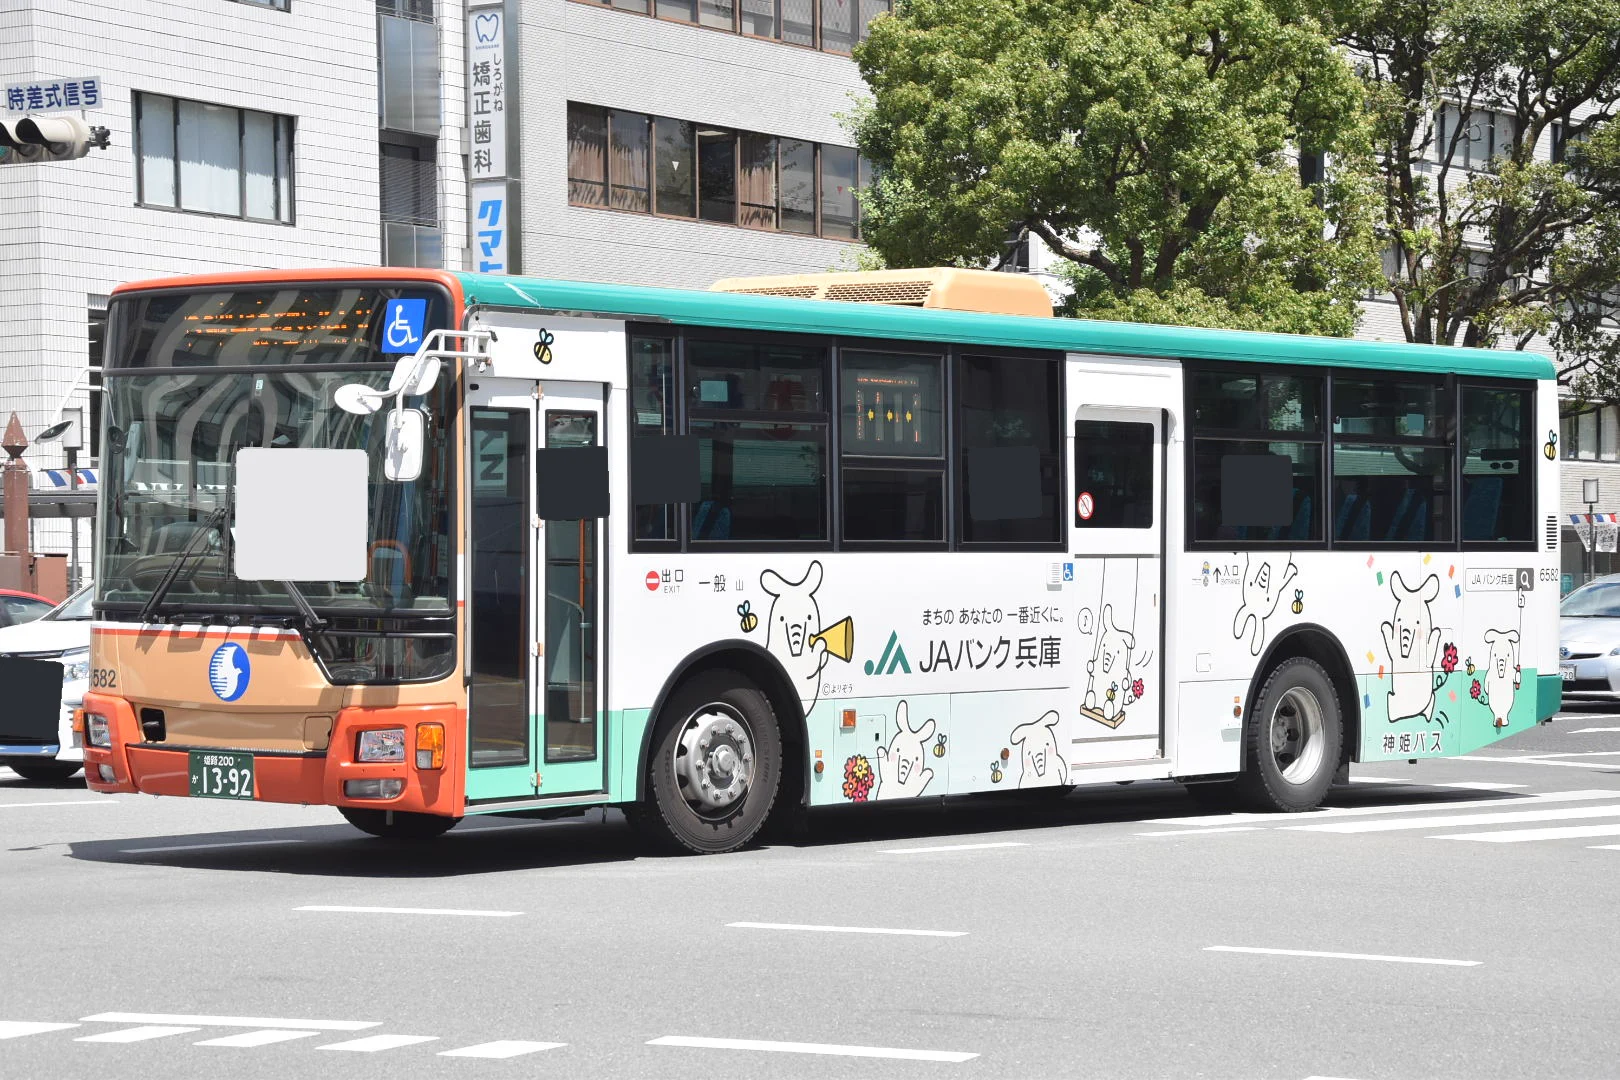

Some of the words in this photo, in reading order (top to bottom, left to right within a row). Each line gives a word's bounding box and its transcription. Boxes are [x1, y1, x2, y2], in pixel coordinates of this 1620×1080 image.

[493, 53, 503, 112] しろがね
[7, 80, 98, 110] 時差式信号
[472, 60, 492, 173] 矯正歯科
[661, 568, 684, 583] 出口
[1224, 564, 1239, 577] 入口
[1539, 568, 1559, 582] 6582
[663, 585, 681, 594] EXIT
[698, 574, 726, 592] 一般
[922, 608, 955, 626] まちの
[959, 607, 1003, 625] あなたの
[1007, 605, 1064, 624] 一番近くに。
[919, 635, 1062, 673] JAバンク兵庫
[90, 668, 117, 688] 582
[1383, 732, 1442, 753] 神姫バス
[191, 774, 199, 784] か
